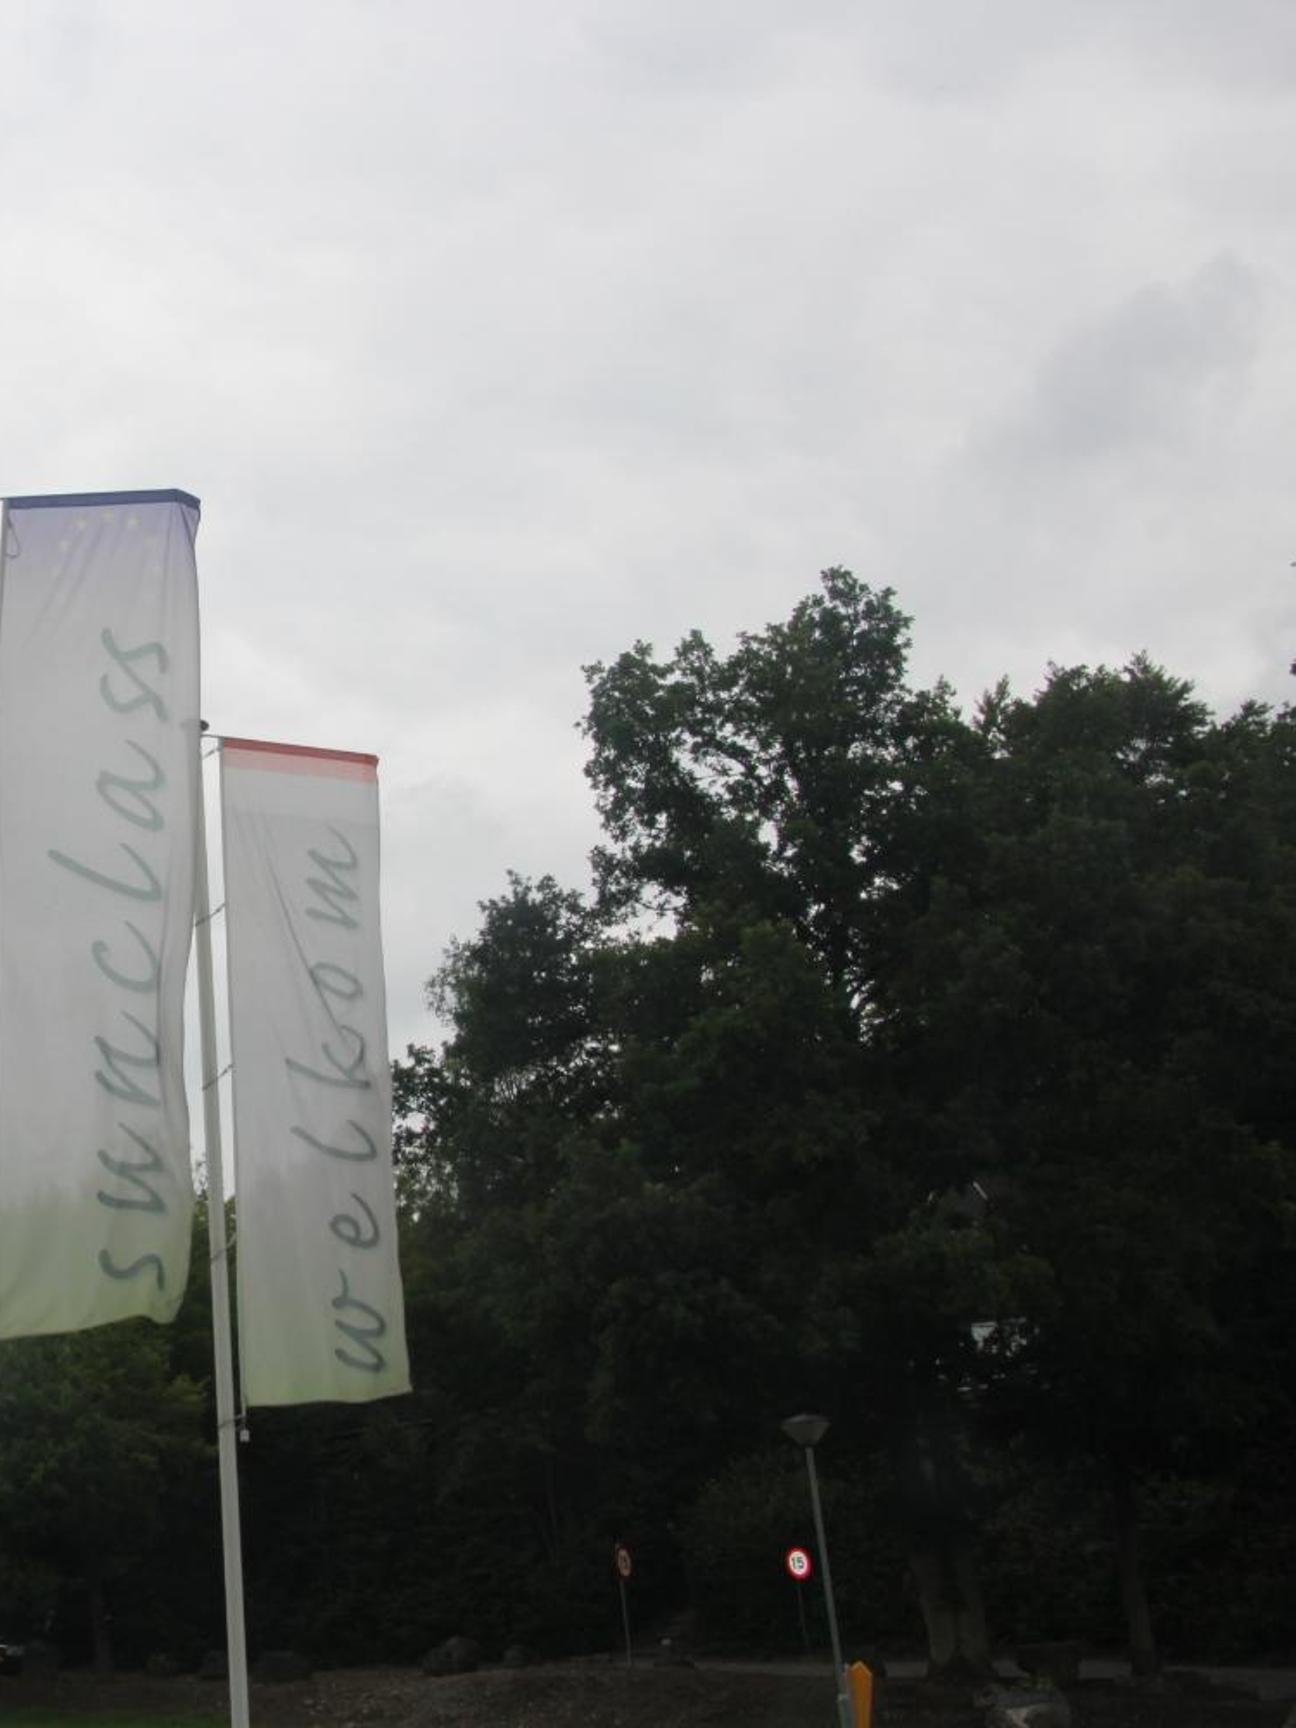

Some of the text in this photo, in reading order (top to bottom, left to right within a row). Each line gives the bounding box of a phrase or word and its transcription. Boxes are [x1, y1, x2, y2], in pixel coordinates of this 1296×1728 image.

[49, 629, 167, 1290] sunclass
[285, 824, 387, 1374] welkom
[791, 1556, 804, 1570] 15
